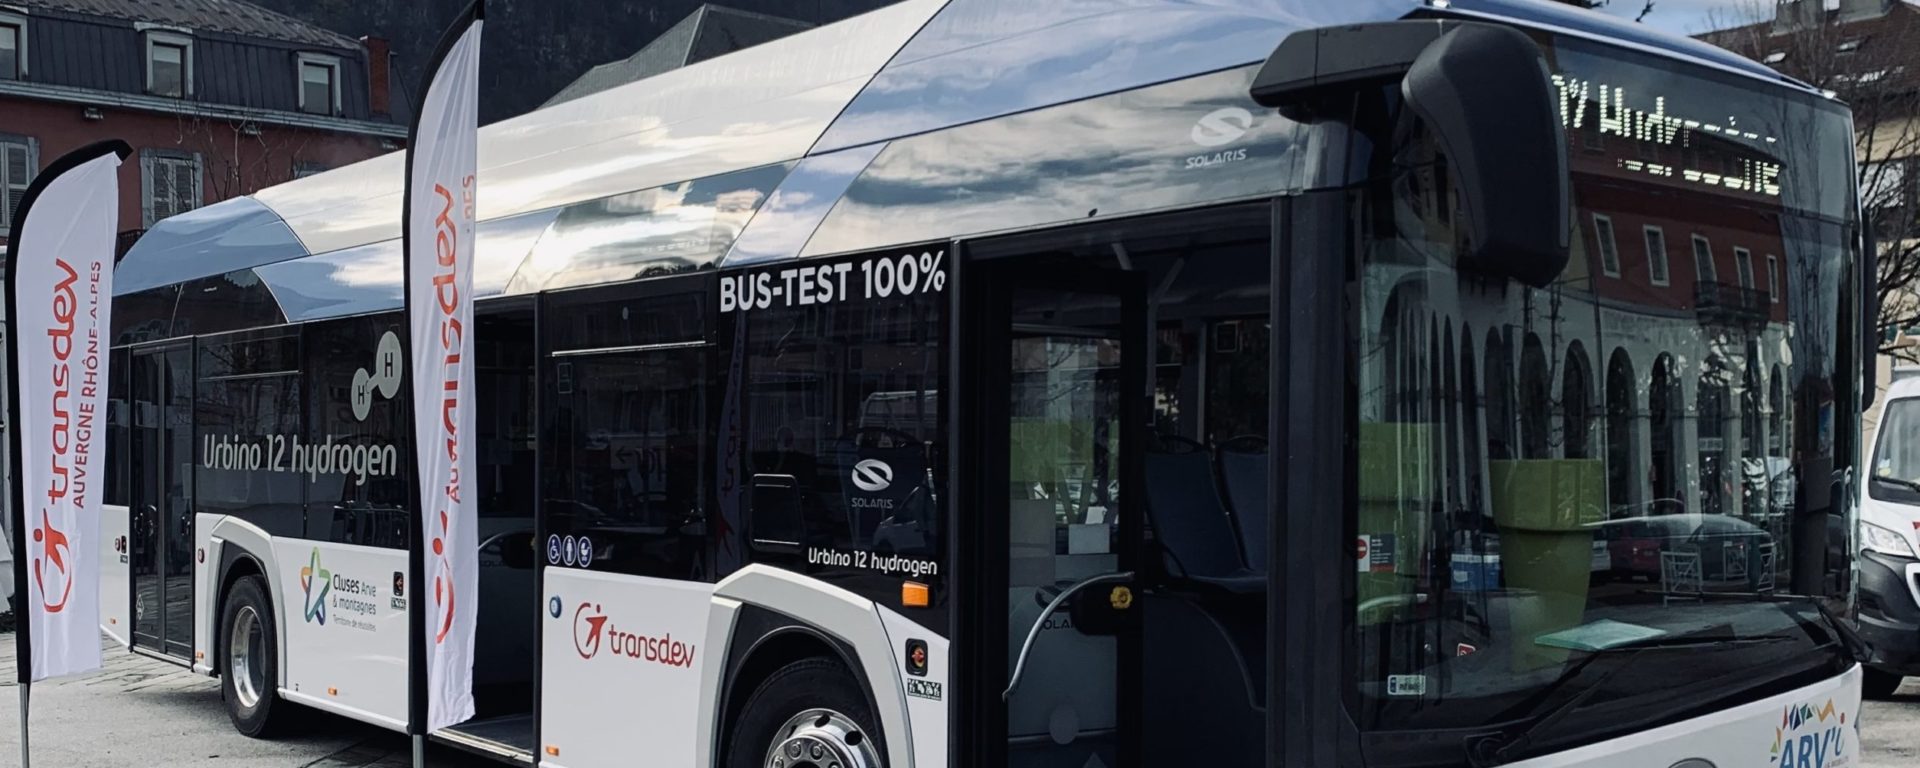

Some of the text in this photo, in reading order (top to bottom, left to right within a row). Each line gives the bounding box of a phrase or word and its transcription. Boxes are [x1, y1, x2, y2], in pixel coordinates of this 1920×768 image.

[1185, 148, 1247, 169] SOLARIS
[720, 250, 946, 313] BUS-TEST 100%
[385, 352, 394, 378] H
[47, 258, 78, 505] transdev
[73, 261, 101, 509] AUVERGNE RHÔNE-ALPES
[357, 385, 365, 405] H
[203, 433, 397, 486] Urbino 12 hydrogen
[851, 497, 894, 509] SOLARIS
[808, 547, 938, 577] Urbino 12 hydrogen
[333, 574, 360, 594] Cluses
[339, 598, 377, 615] montagnes
[608, 624, 695, 669] transdev
